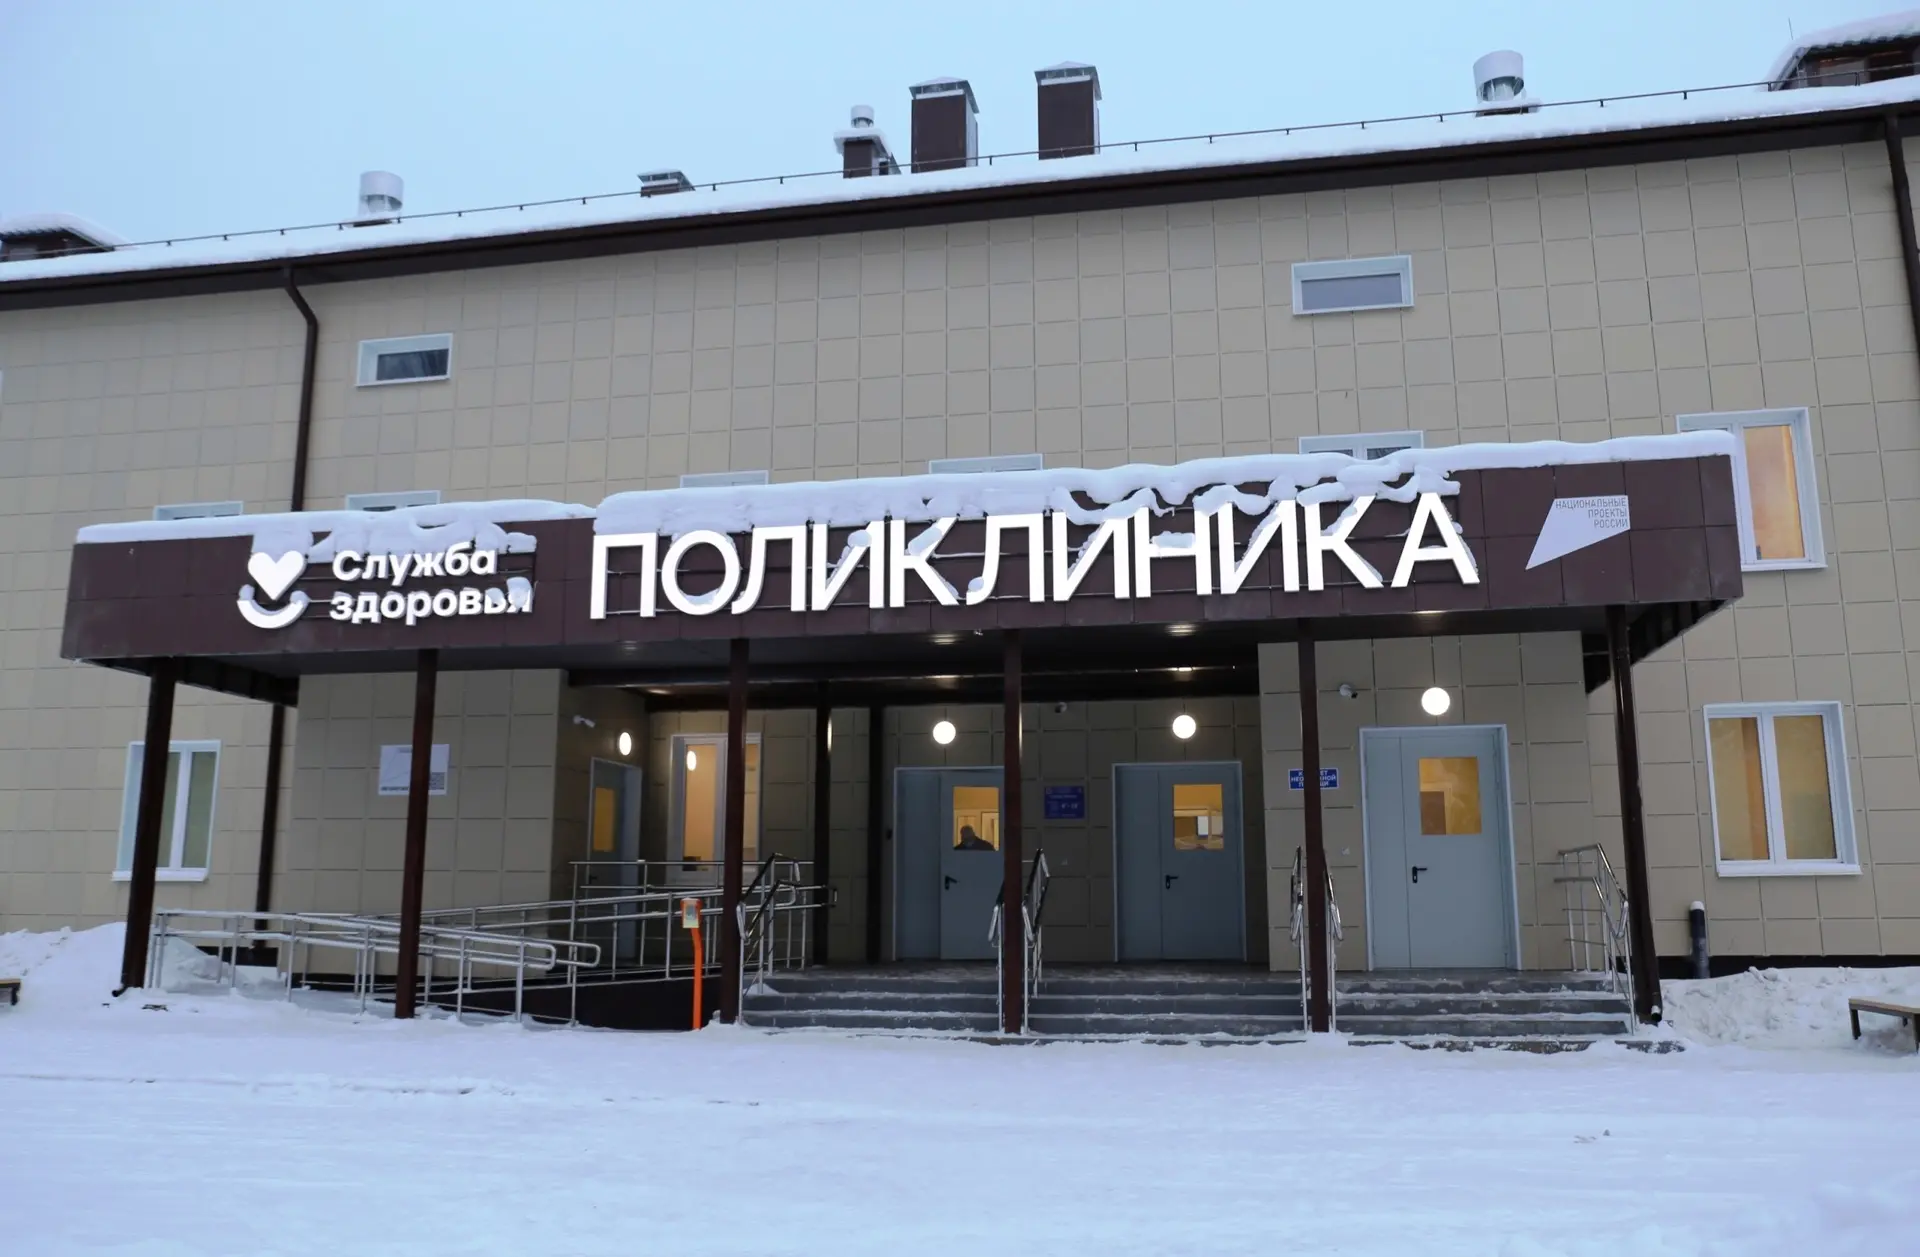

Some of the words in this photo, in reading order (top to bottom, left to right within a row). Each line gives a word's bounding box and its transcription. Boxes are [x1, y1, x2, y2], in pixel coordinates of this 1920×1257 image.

[1556, 497, 1626, 509] НАЦИОНАЛЬНЫЕ
[1588, 508, 1627, 518] ПРОЕКТЫ
[1594, 519, 1628, 528] РОССИИ
[590, 491, 1480, 619] ПОЛИКЛИНИКА
[332, 541, 498, 586] Служба
